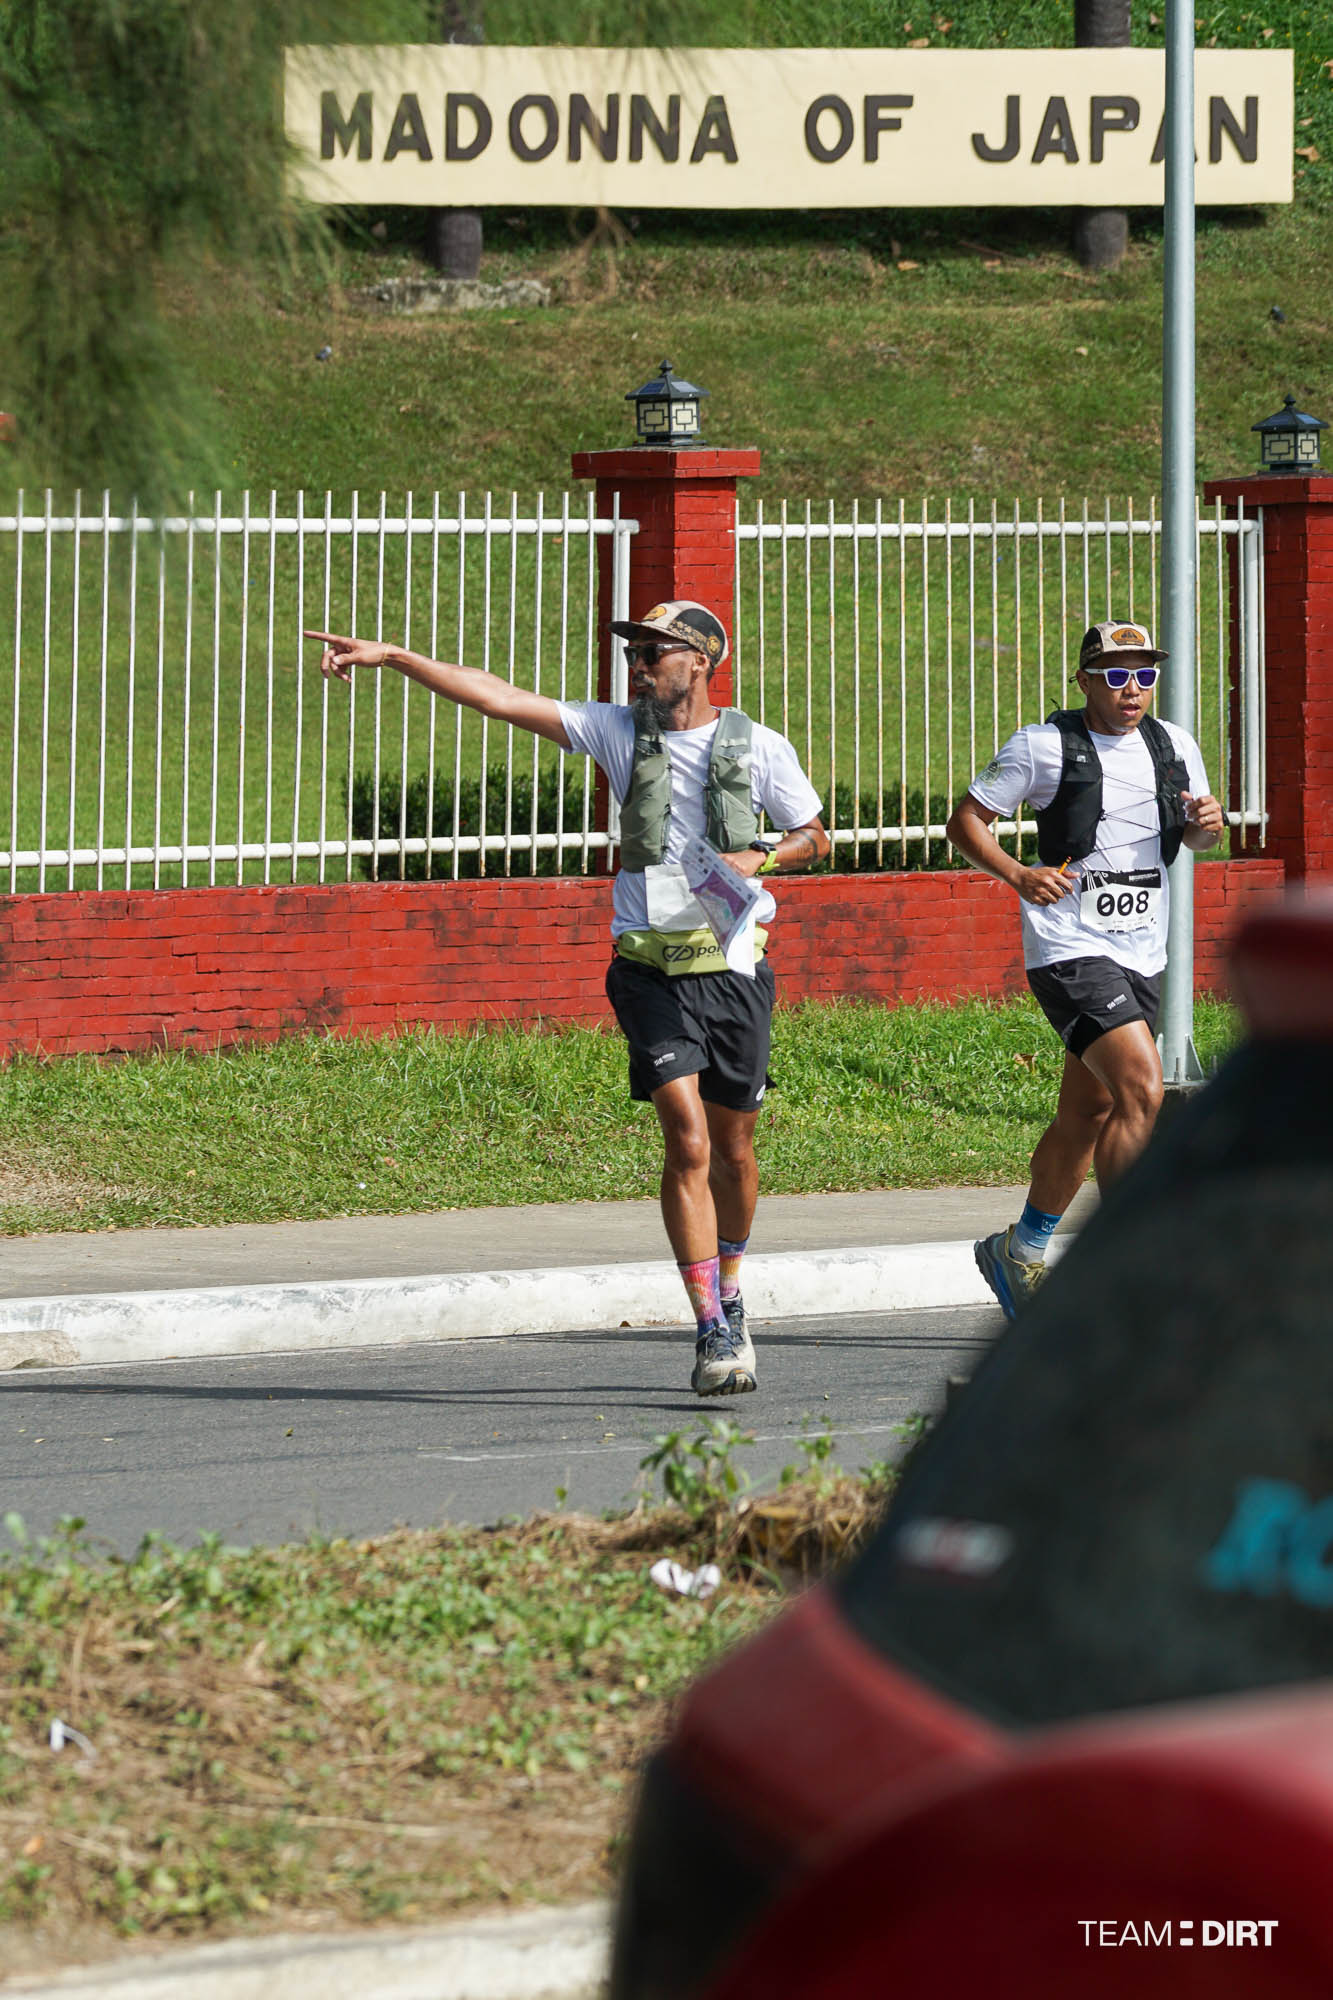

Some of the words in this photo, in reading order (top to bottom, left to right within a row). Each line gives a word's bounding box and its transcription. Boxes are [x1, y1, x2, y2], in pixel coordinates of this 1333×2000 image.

[319, 90, 740, 164] MADONNA
[804, 93, 914, 164] OF
[971, 94, 1259, 165] JAPN
[1096, 890, 1149, 917] 008
